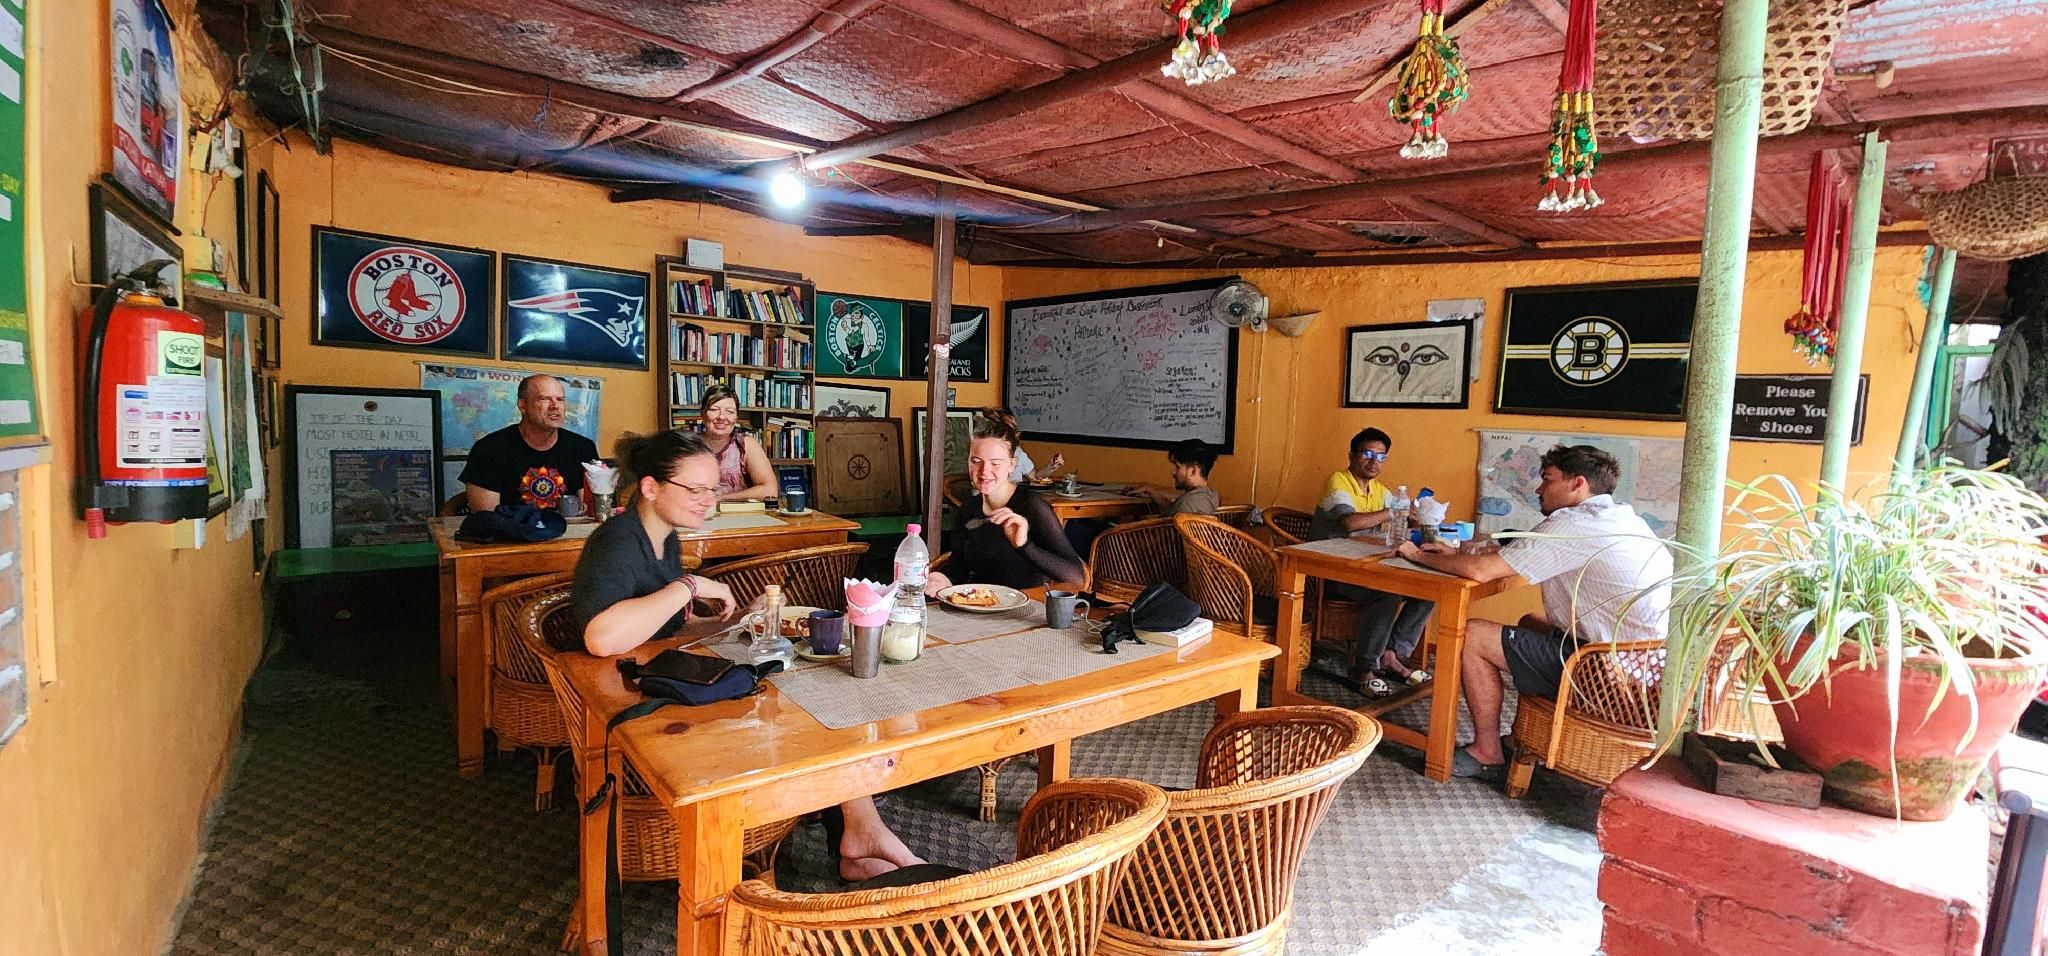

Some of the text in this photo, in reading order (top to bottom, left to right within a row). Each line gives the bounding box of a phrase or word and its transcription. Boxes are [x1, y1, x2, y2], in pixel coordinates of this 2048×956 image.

[362, 254, 453, 288] BOSTON
[366, 309, 451, 338] RED SOX
[869, 312, 884, 351] CELTICS
[828, 315, 842, 357] BOSTON
[169, 343, 200, 355] SHOOT
[1569, 332, 1608, 371] B
[178, 356, 195, 365] FIRE
[1765, 385, 1816, 398] Please
[1734, 403, 1829, 418] Remove You
[1759, 421, 1813, 434] Shoes
